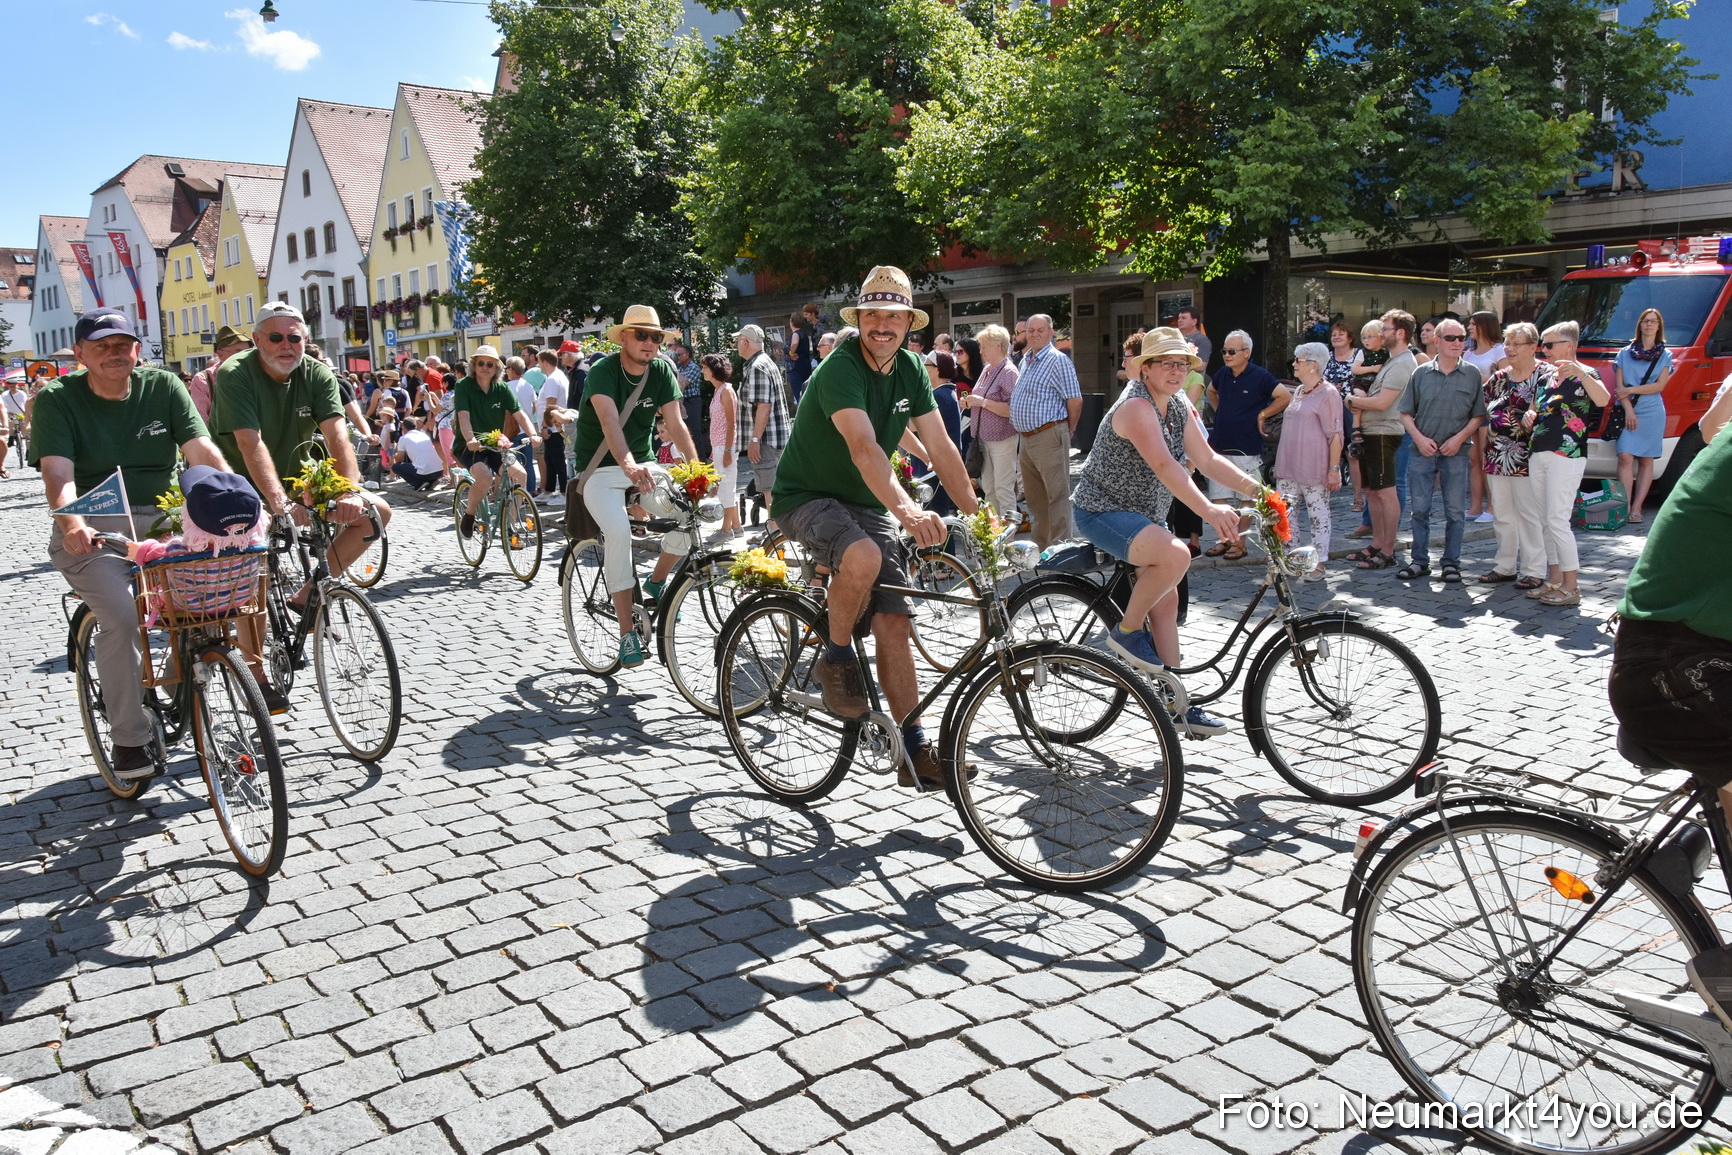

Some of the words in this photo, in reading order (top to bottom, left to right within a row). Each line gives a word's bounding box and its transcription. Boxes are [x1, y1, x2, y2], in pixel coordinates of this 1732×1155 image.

[183, 292, 196, 303] HOTEL
[386, 331, 394, 345] P
[88, 498, 119, 512] EXPRESS
